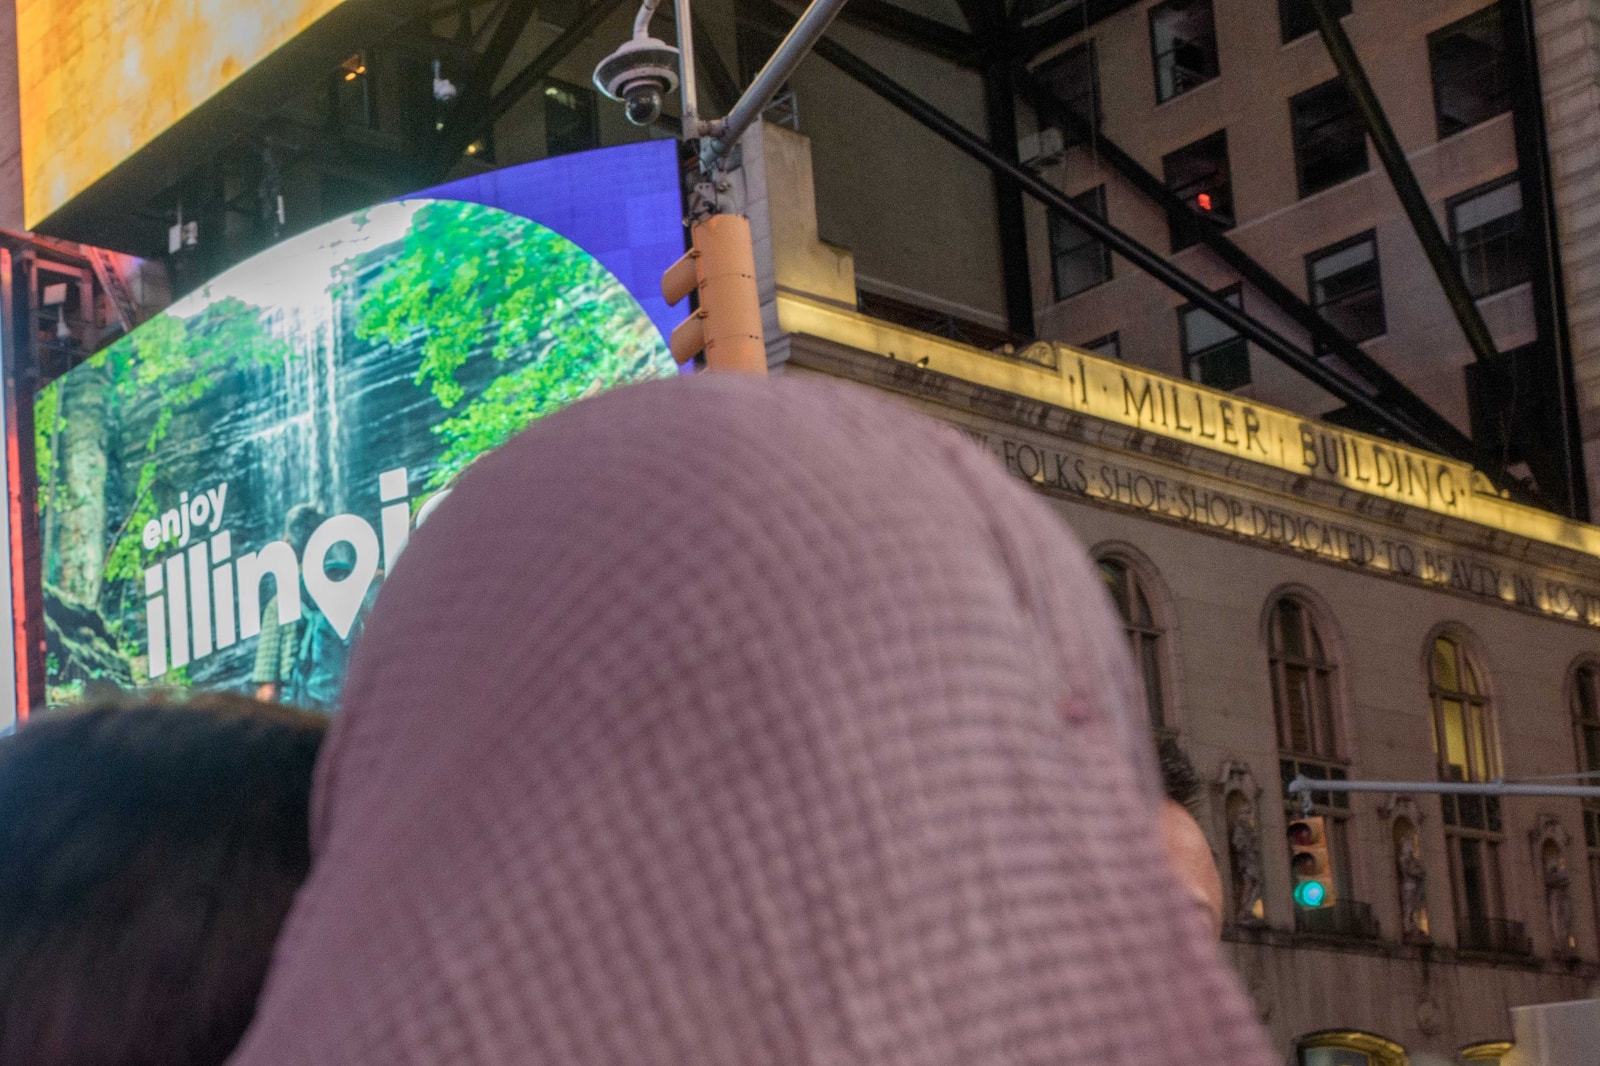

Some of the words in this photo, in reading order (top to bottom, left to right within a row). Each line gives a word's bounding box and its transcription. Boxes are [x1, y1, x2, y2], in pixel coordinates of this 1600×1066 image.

[1004, 440, 1088, 494] FOLKS
[1100, 465, 1170, 514] SHOE
[1177, 484, 1242, 532] SHOP
[1251, 506, 1375, 563] DEDICATED
[1121, 372, 1269, 455] MILLER
[1299, 422, 1458, 507] BUILDING
[142, 482, 228, 551] enjoy
[145, 467, 454, 680] illinoi
